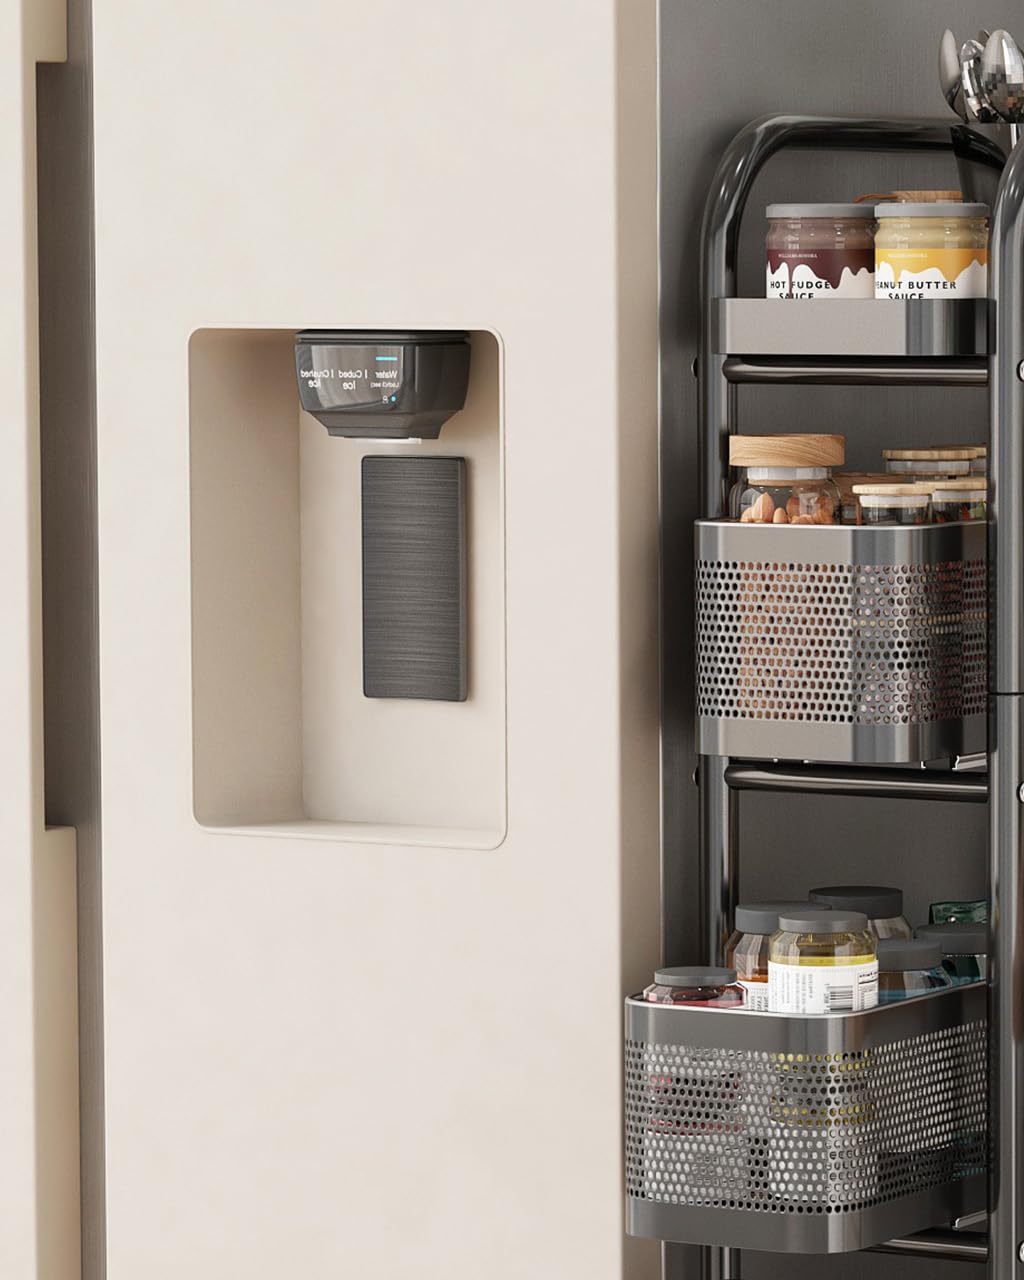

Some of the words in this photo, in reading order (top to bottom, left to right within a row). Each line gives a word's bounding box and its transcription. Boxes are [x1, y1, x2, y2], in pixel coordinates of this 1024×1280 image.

[770, 281, 786, 289] HOT
[791, 281, 830, 289] FUDGE
[876, 281, 903, 289] EANUT
[908, 281, 957, 289] BUTTER
